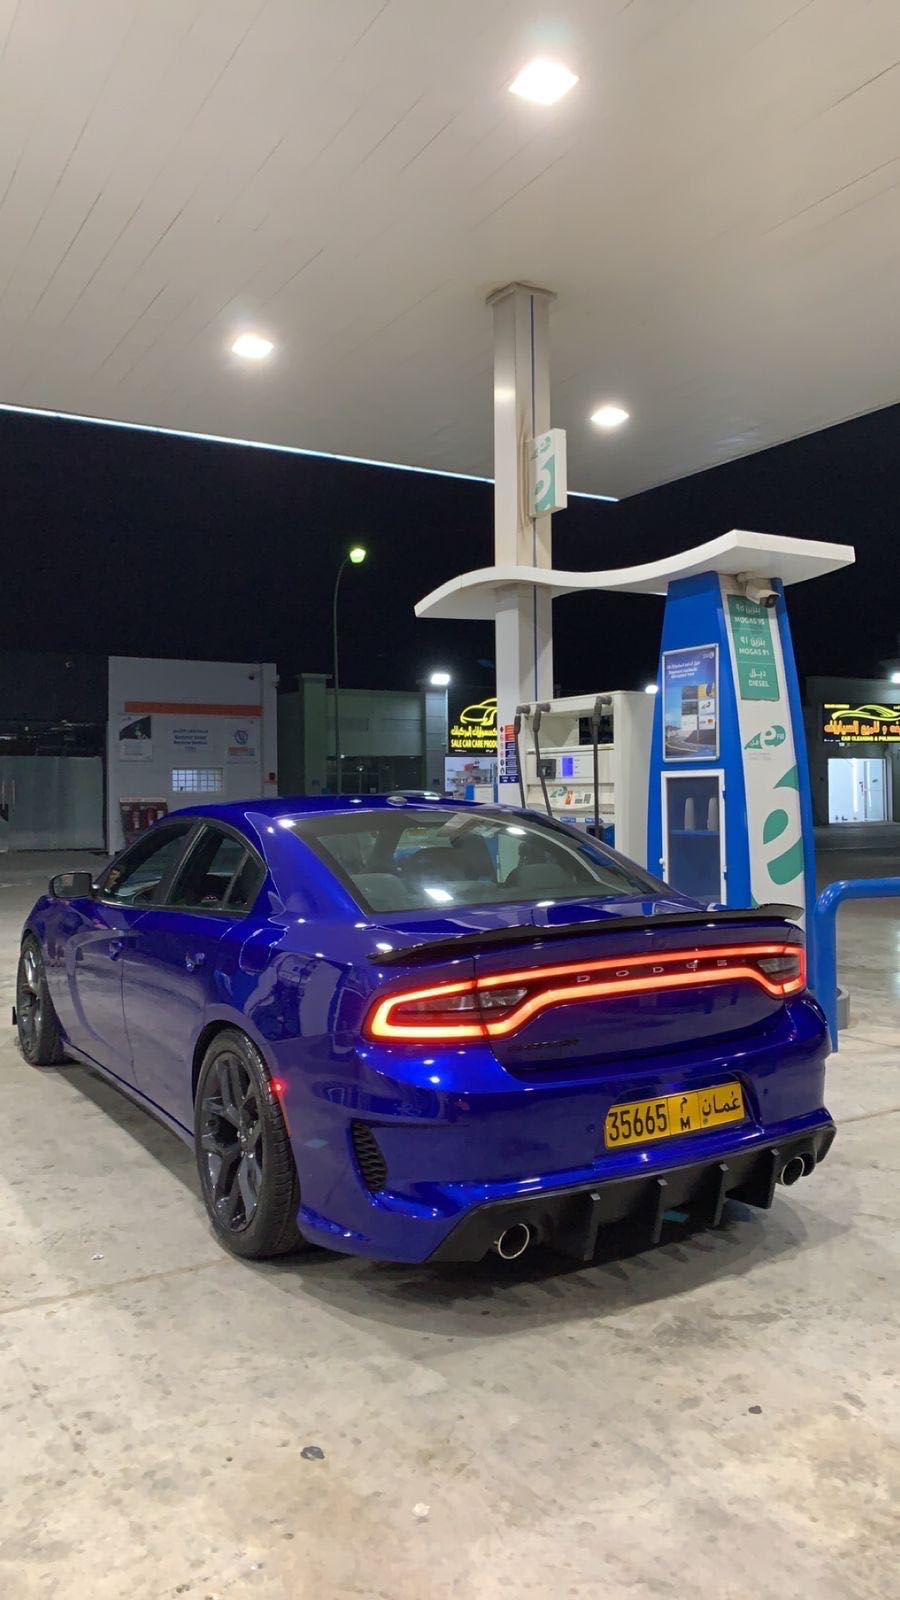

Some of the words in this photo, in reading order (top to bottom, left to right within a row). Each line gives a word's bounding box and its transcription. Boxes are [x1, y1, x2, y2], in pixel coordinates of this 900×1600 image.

[734, 616, 757, 625] MOGAS
[739, 647, 762, 656] MOGAS
[762, 648, 770, 656] 91
[748, 680, 769, 688] DIESEL
[824, 720, 859, 735] السيارات
[451, 739, 462, 748] SALE
[462, 739, 472, 748] CAR
[472, 739, 484, 748] CARE
[576, 959, 728, 983] DODGE
[680, 1096, 688, 1113] م
[608, 1103, 667, 1141] 35665
[680, 1116, 691, 1131] M
